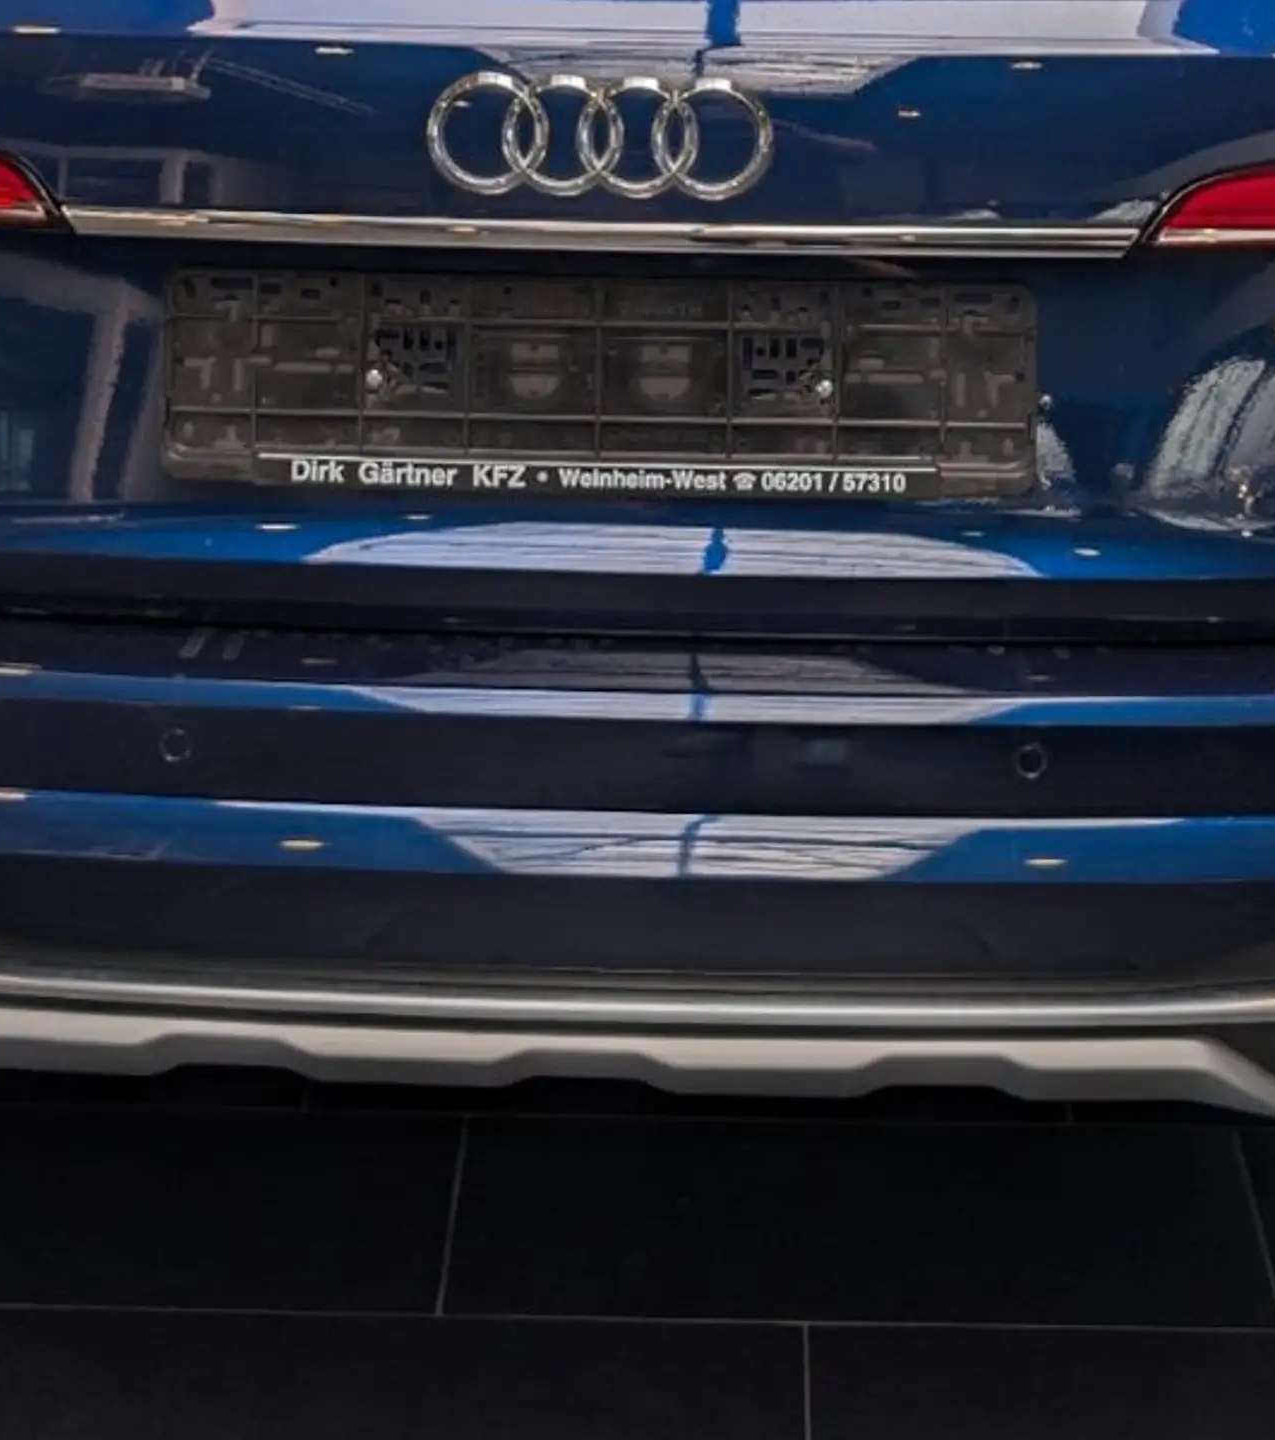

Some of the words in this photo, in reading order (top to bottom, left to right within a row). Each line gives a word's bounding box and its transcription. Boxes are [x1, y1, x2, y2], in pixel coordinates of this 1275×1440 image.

[290, 460, 346, 483] Dirk
[358, 460, 458, 487] Gärtner
[473, 464, 527, 489] KFZ
[558, 467, 727, 491] Weinheim-West
[760, 471, 824, 493] 06201
[842, 472, 907, 494] 57310
